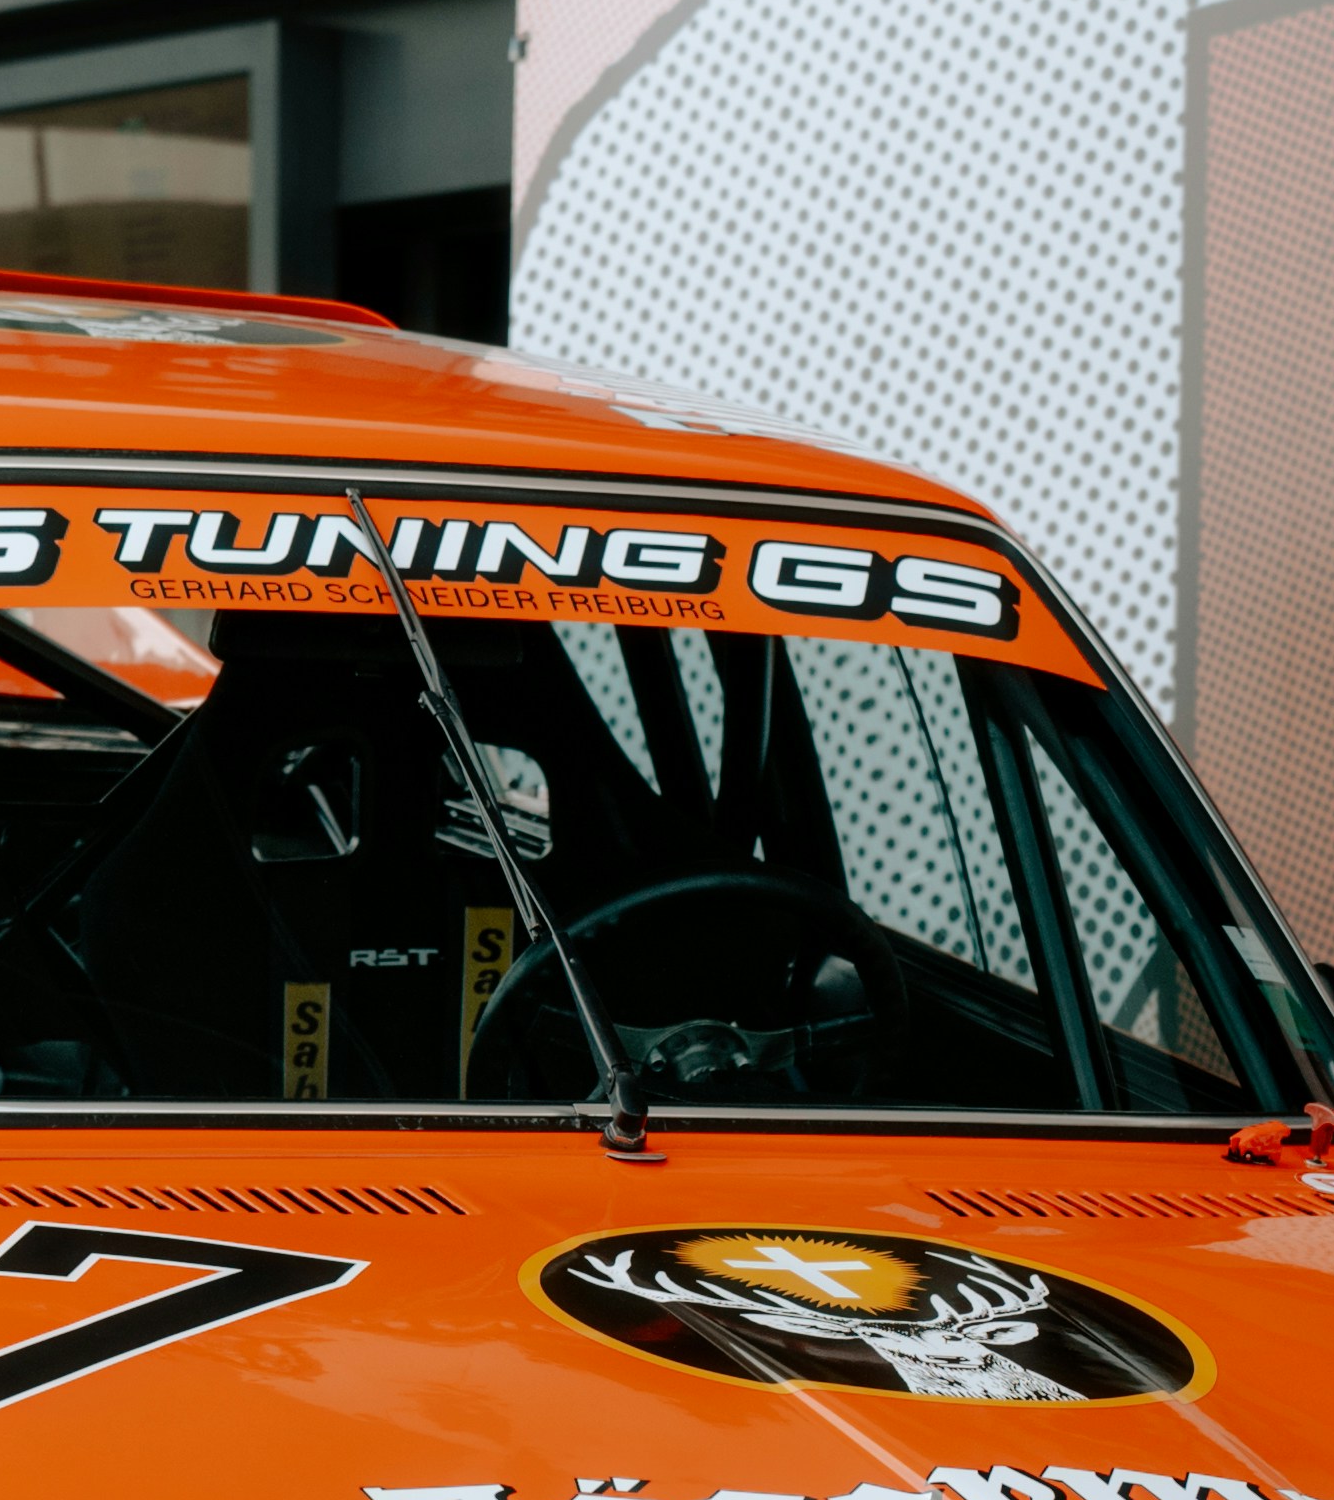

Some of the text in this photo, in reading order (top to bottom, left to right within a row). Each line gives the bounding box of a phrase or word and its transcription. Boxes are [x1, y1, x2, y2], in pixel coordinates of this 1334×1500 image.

[93, 508, 727, 595] TUNING
[747, 539, 1021, 642] GS
[129, 578, 726, 622] GERHARD SCHNEIDER FREIBURG
[350, 949, 439, 968] RST
